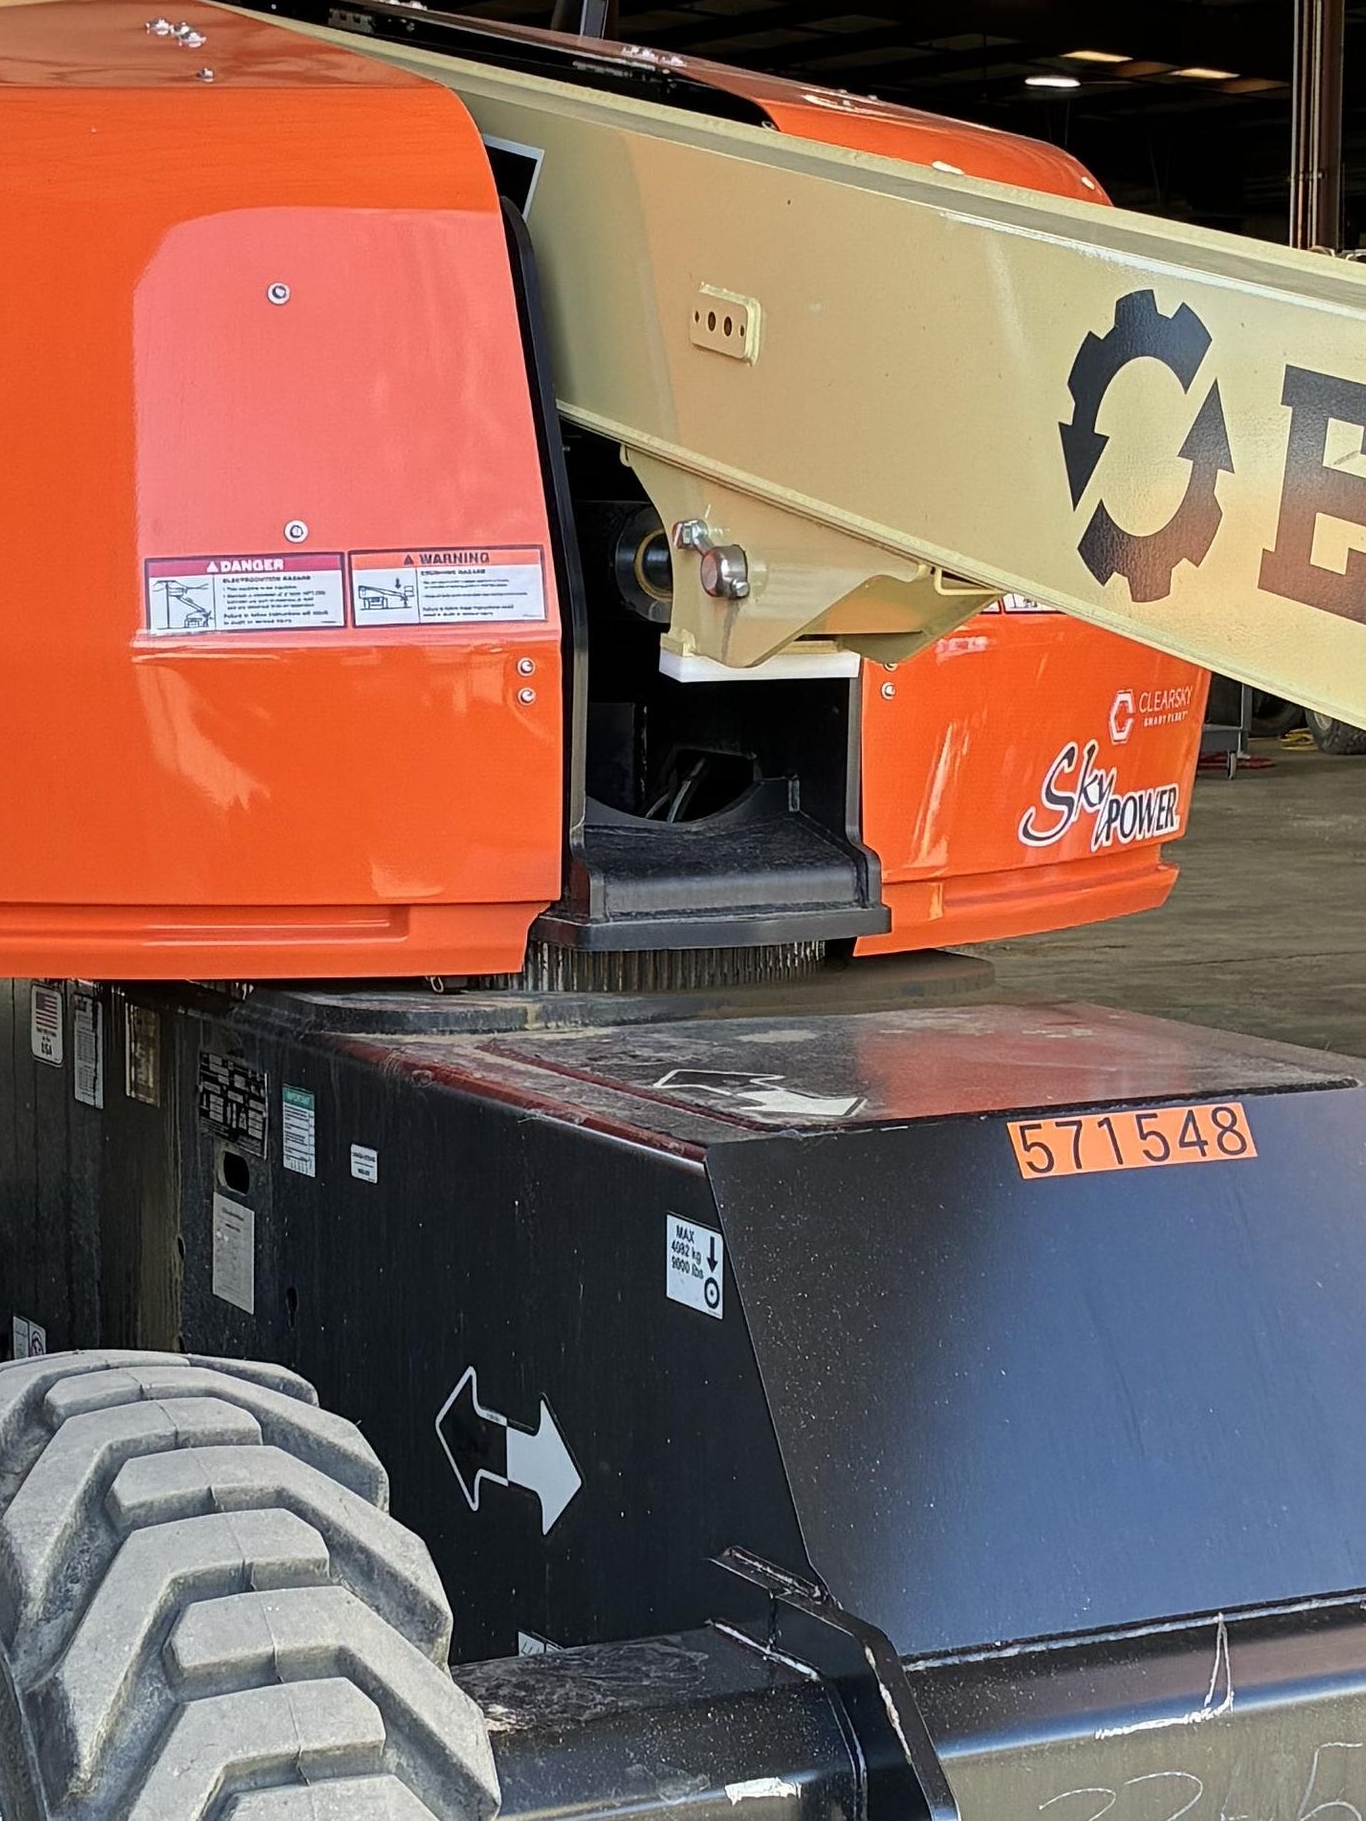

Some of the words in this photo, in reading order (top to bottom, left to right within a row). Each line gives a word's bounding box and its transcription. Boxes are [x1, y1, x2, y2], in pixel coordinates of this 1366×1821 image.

[219, 558, 285, 573] DANGER
[420, 551, 490, 565] WARNING
[1138, 686, 1193, 713] CLEARSKY
[1101, 784, 1180, 845] POWER
[1019, 1106, 1248, 1173] 571548
[676, 1224, 695, 1244] MAX
